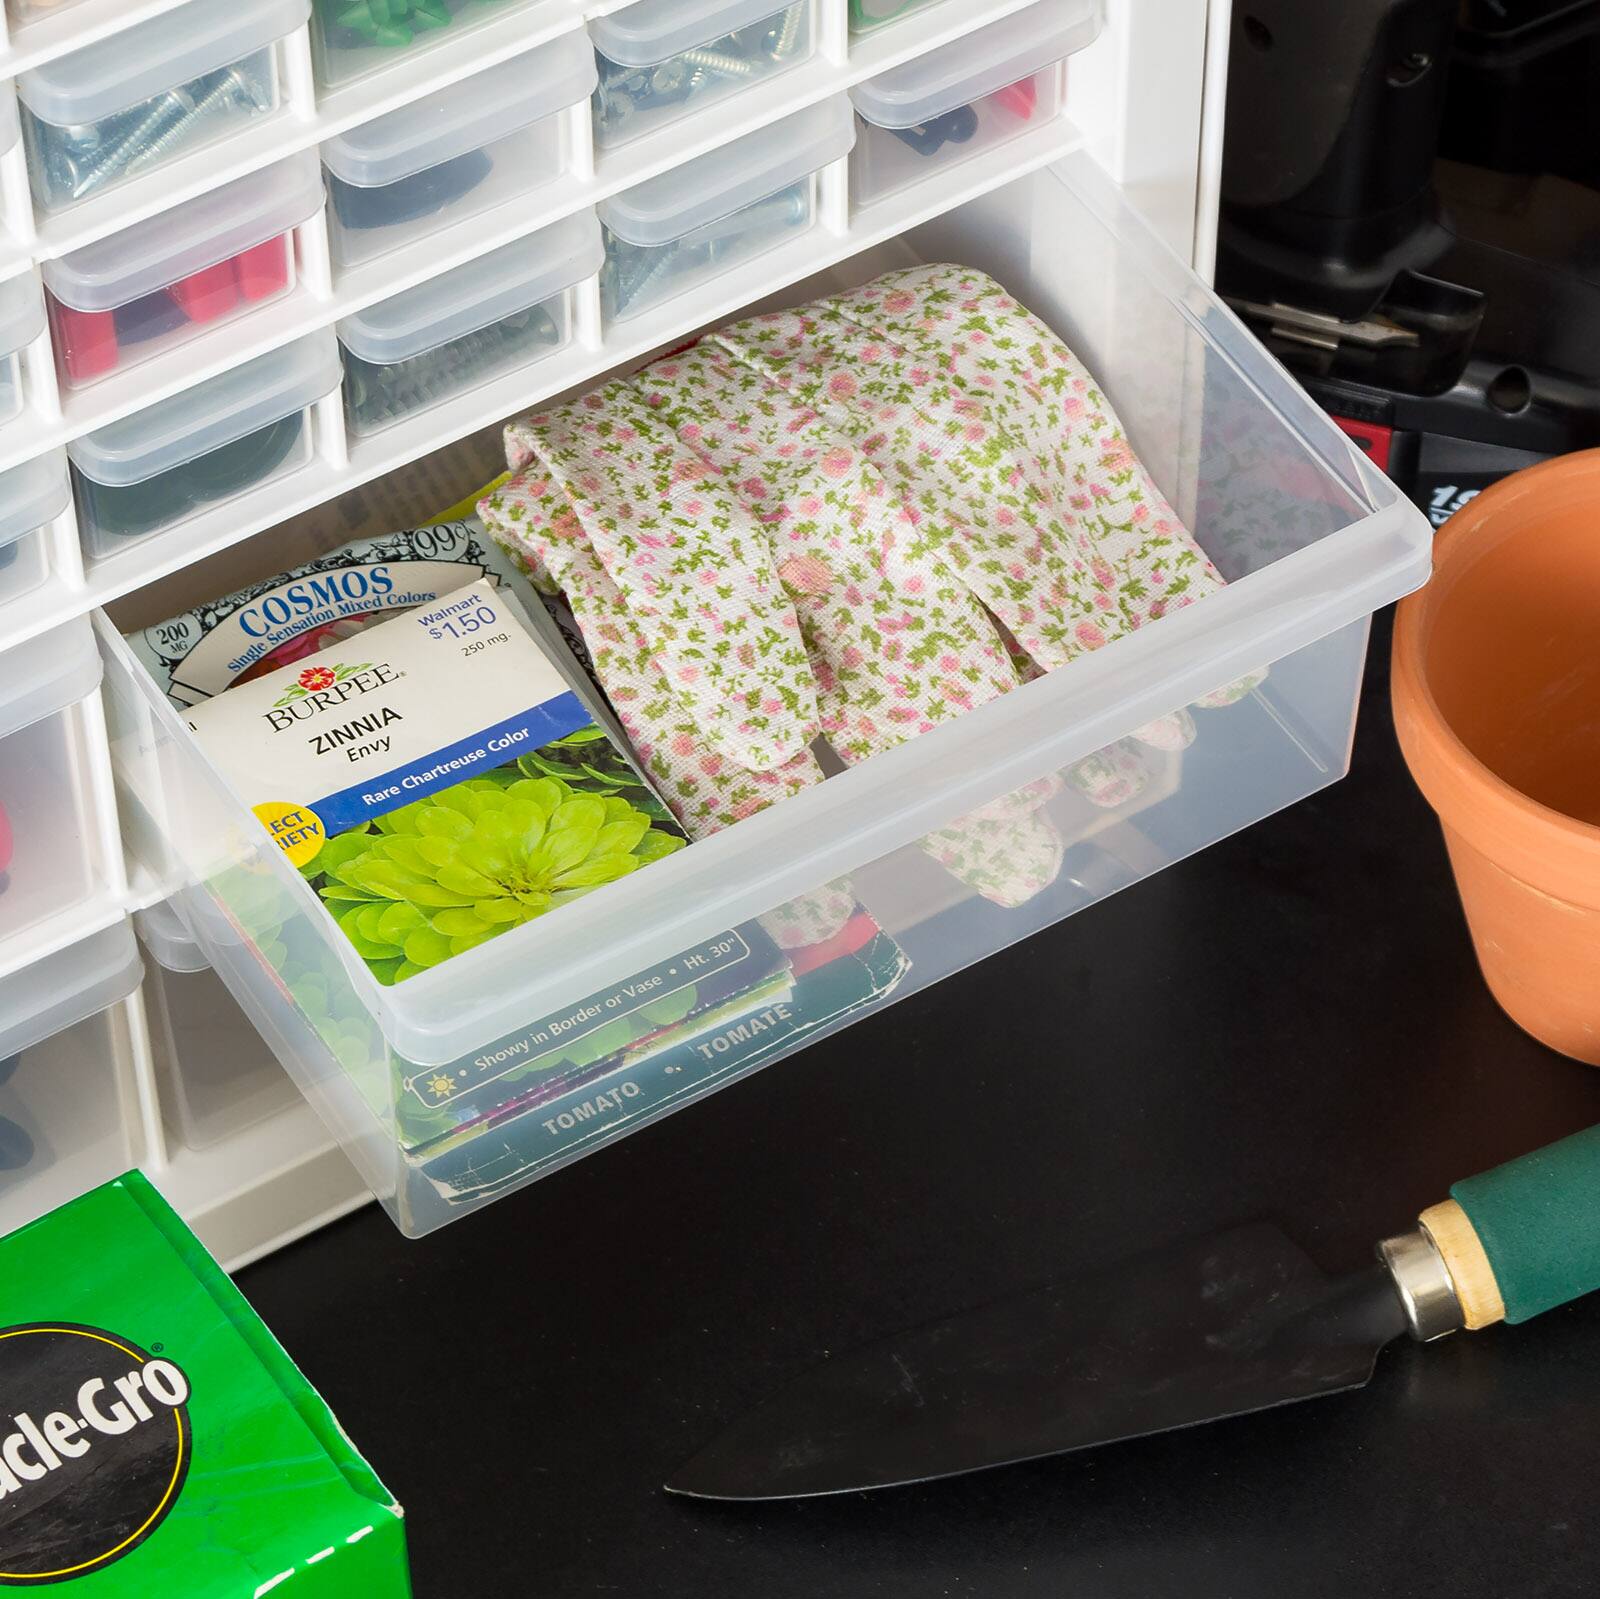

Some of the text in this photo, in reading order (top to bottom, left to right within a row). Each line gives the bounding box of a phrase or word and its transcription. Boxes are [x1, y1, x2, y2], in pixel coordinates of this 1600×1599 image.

[239, 566, 394, 638] COSMOS
[417, 593, 482, 628] Walmart
[156, 621, 190, 646] 200
[226, 590, 437, 673] Single Sensation Mixed Colors
[428, 606, 497, 641] $1.50
[170, 640, 188, 653] MG
[461, 632, 512, 657] 250 mg.
[262, 664, 401, 732] BURPEE
[308, 706, 404, 756] ZINNIA
[346, 734, 393, 763] Envy
[361, 726, 530, 807] Rare Chartreuse Color
[270, 811, 304, 836] ECT
[276, 822, 320, 850] IETY
[474, 938, 737, 1072] Showy in Border or Vase Ht. 30"
[542, 1004, 792, 1136] TOMATO TOMATE
